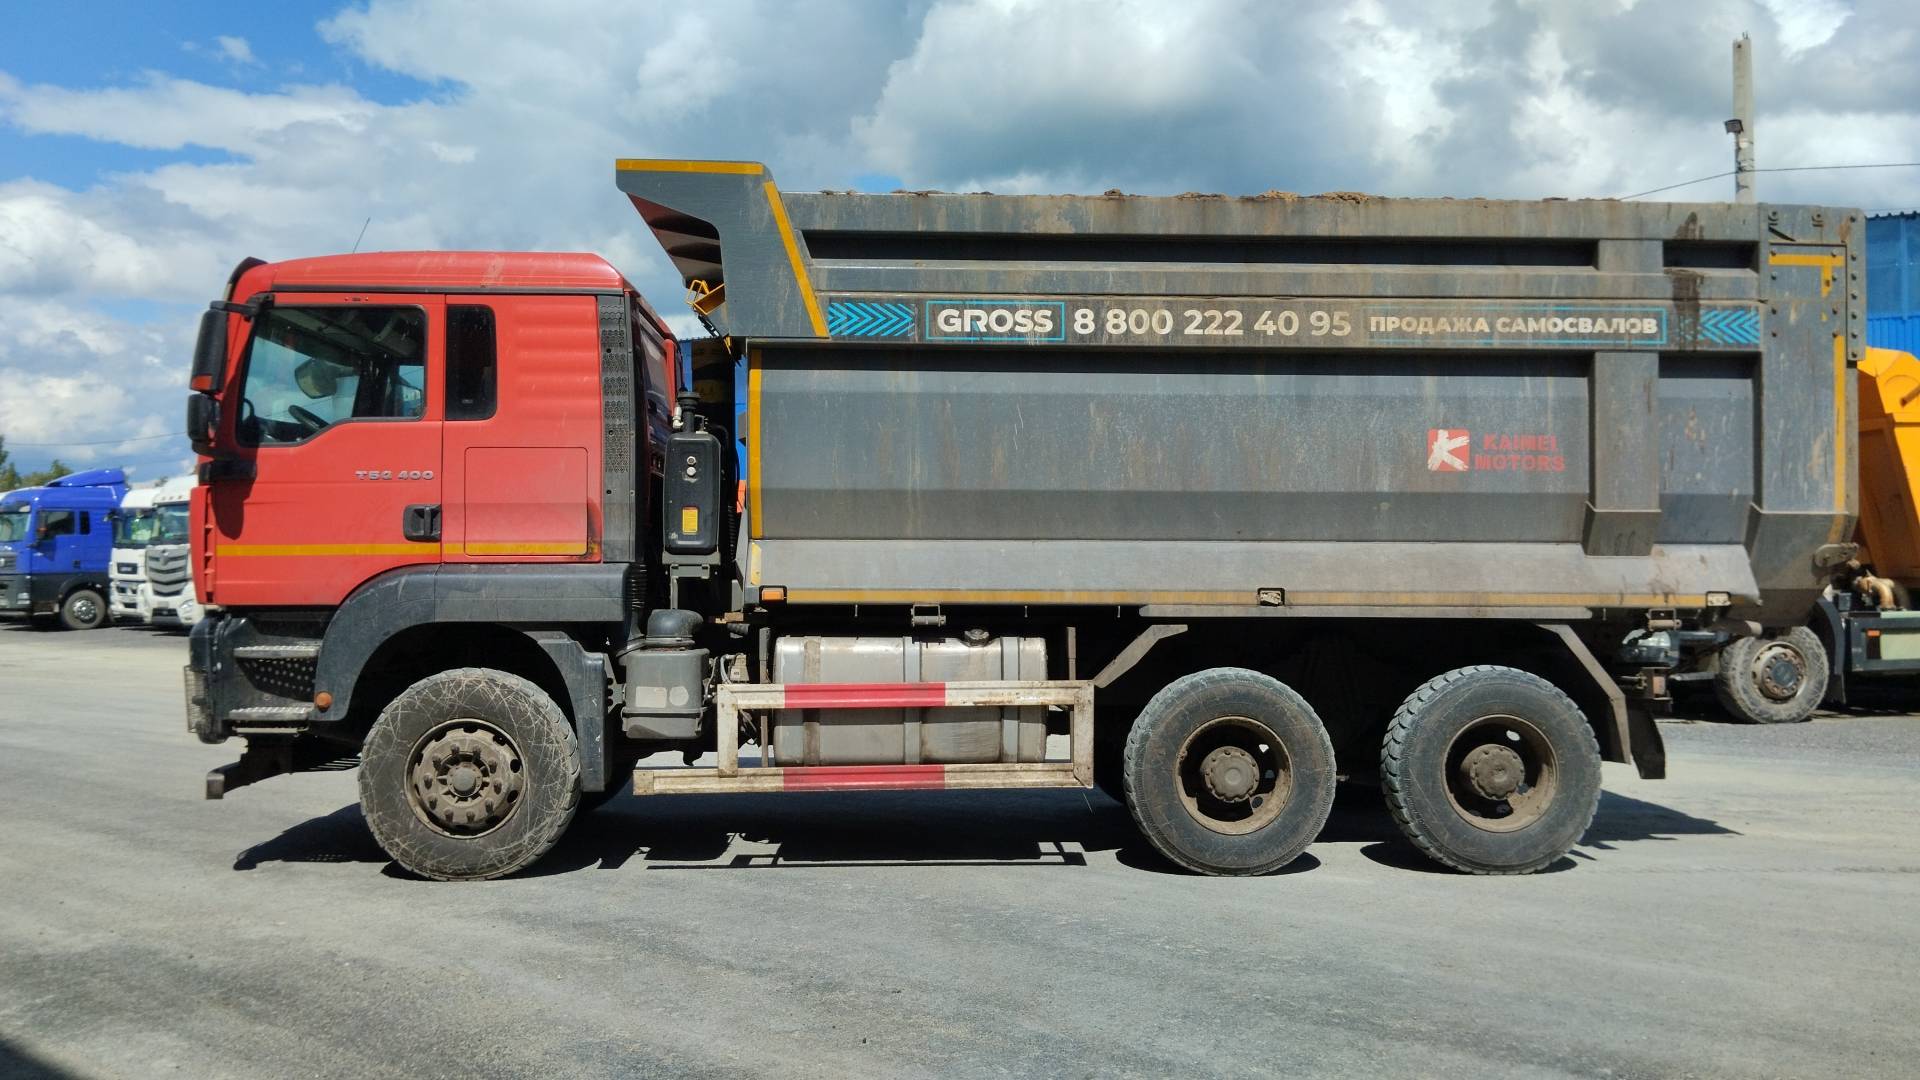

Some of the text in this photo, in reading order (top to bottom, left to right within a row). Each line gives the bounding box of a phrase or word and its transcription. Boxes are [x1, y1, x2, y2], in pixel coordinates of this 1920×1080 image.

[937, 308, 1054, 333] GROSS
[1073, 308, 1352, 336] 8 800 222 40 95
[1370, 316, 1658, 334] ПРОДАЖА САМОСВАЛОВ
[1475, 455, 1566, 472] MOTORS
[398, 470, 435, 480] 400
